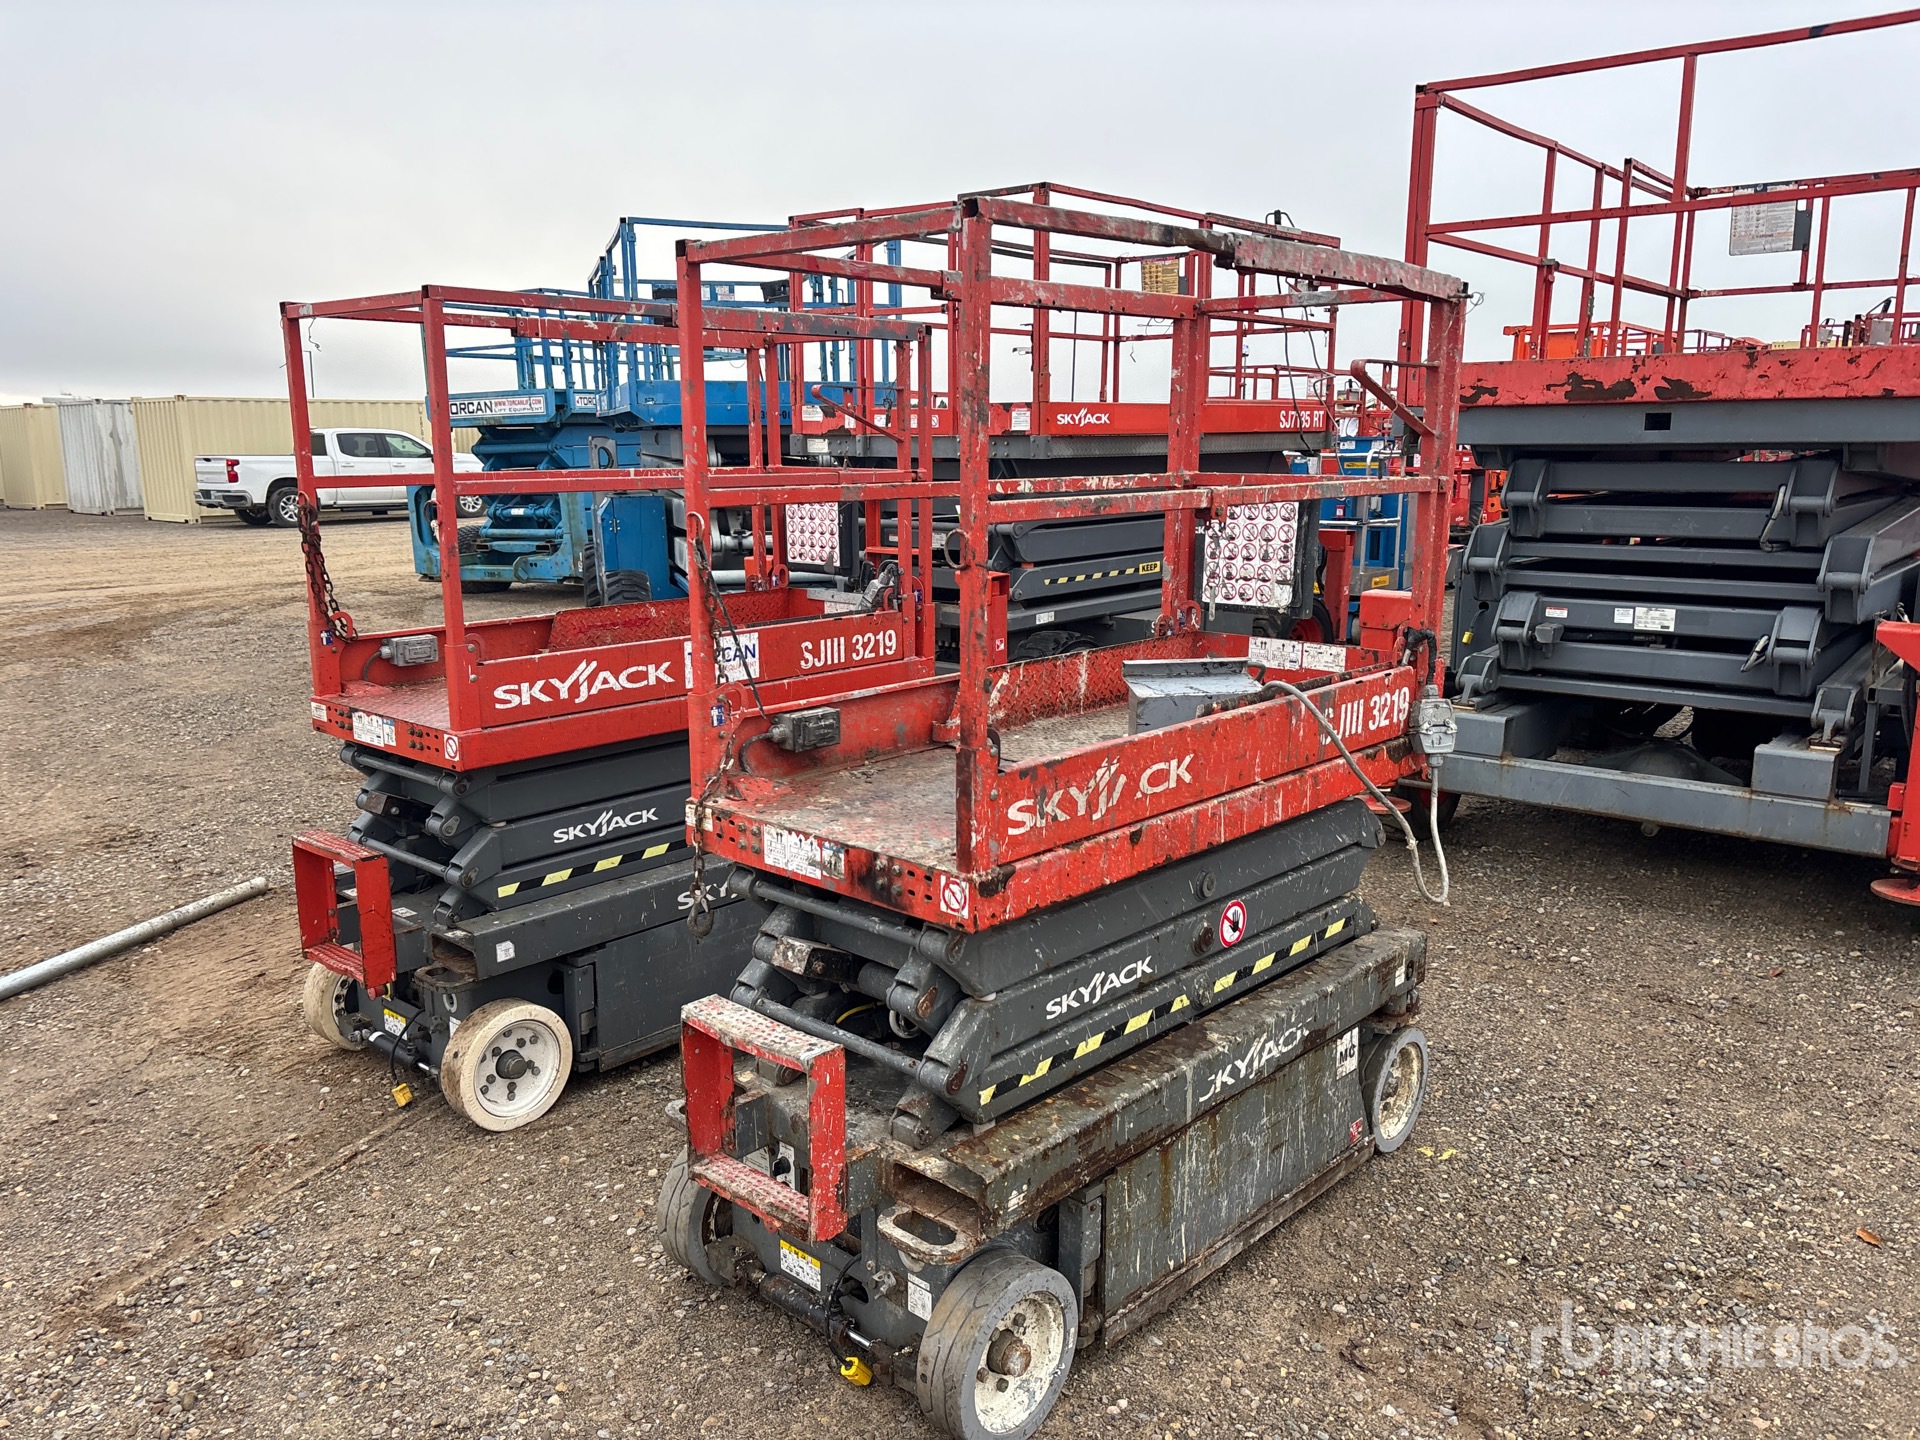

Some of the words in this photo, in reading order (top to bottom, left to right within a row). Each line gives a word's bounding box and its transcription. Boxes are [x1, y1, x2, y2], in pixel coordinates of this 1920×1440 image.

[450, 401, 493, 416] ORCAN
[579, 396, 596, 406] TORC
[1056, 407, 1110, 427] SKYJACK
[1313, 410, 1325, 428] RT
[1141, 562, 1158, 573] KEEP
[800, 636, 845, 670] SJIII
[851, 629, 897, 662] 3219
[493, 659, 676, 710] SKYJACK
[1368, 686, 1410, 731] 3219
[553, 807, 659, 844] SKYJACK
[1045, 955, 1154, 1020] SKYJACK
